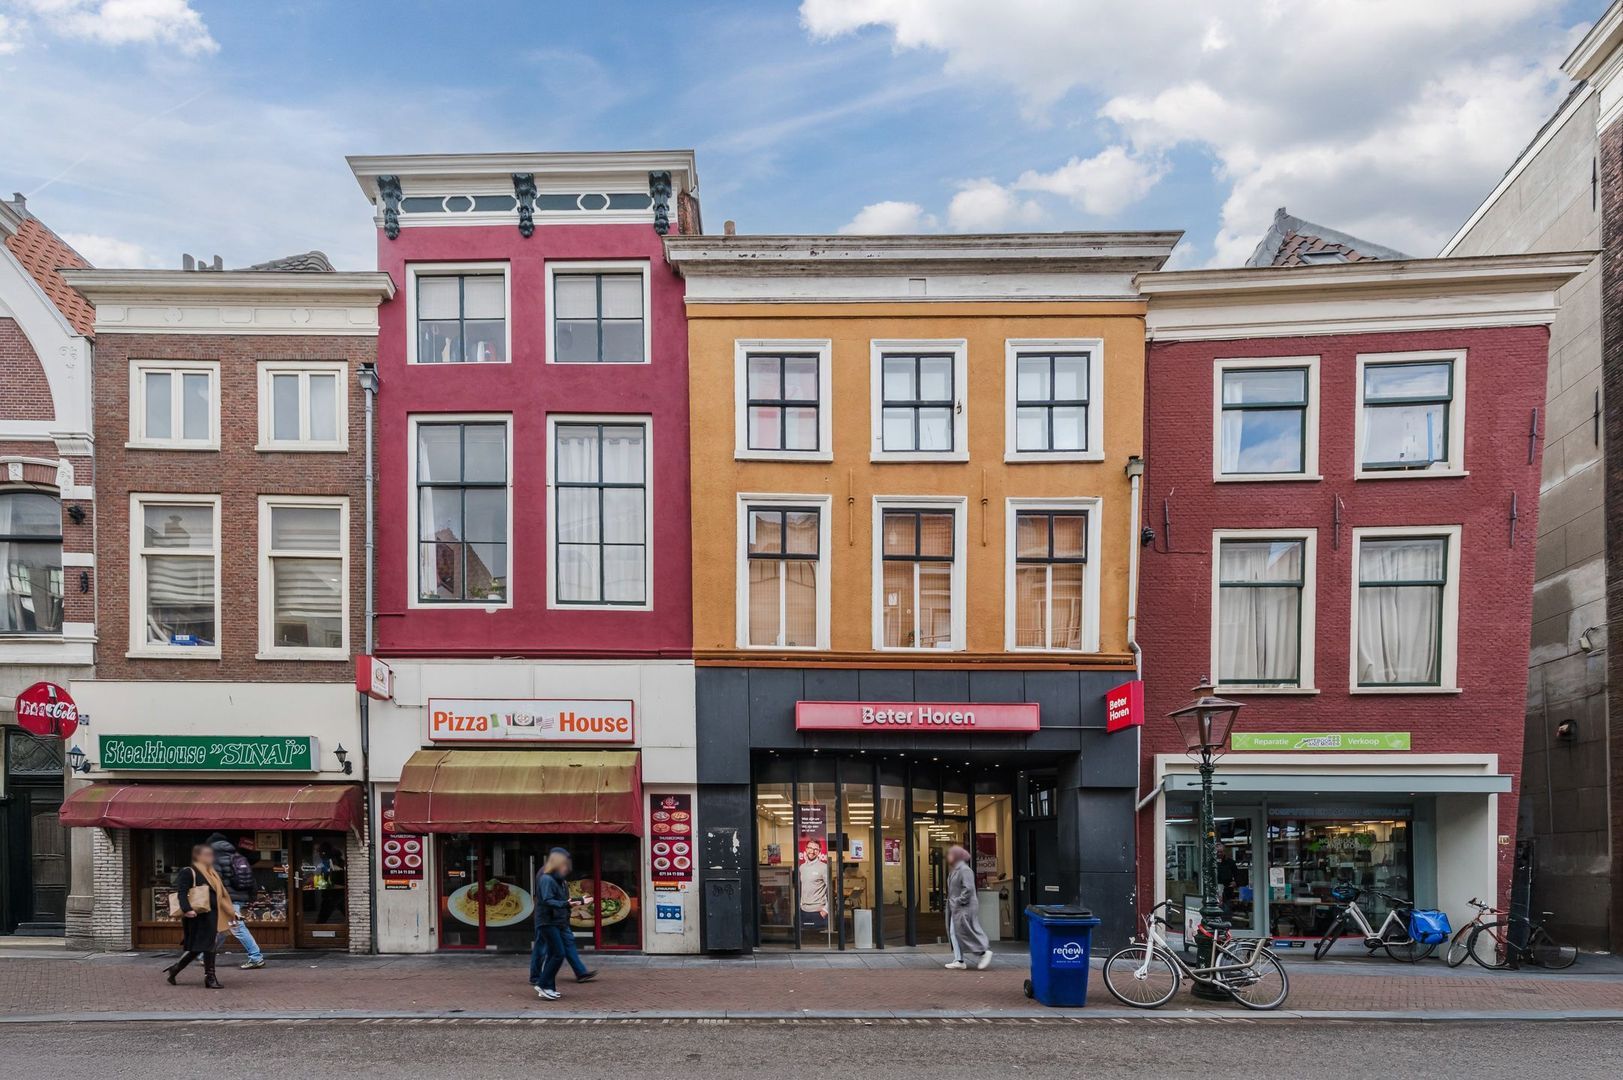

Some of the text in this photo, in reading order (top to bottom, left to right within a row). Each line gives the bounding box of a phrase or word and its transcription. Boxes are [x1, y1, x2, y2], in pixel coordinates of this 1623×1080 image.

[1110, 697, 1127, 711] Beter
[433, 711, 628, 732] Pizza House
[862, 706, 976, 724] Beter Horen
[1110, 708, 1130, 721] Horen
[1254, 737, 1380, 747] Reparatie Verkoop
[104, 740, 206, 764] Steakhouse
[1053, 946, 1084, 955] renewi
